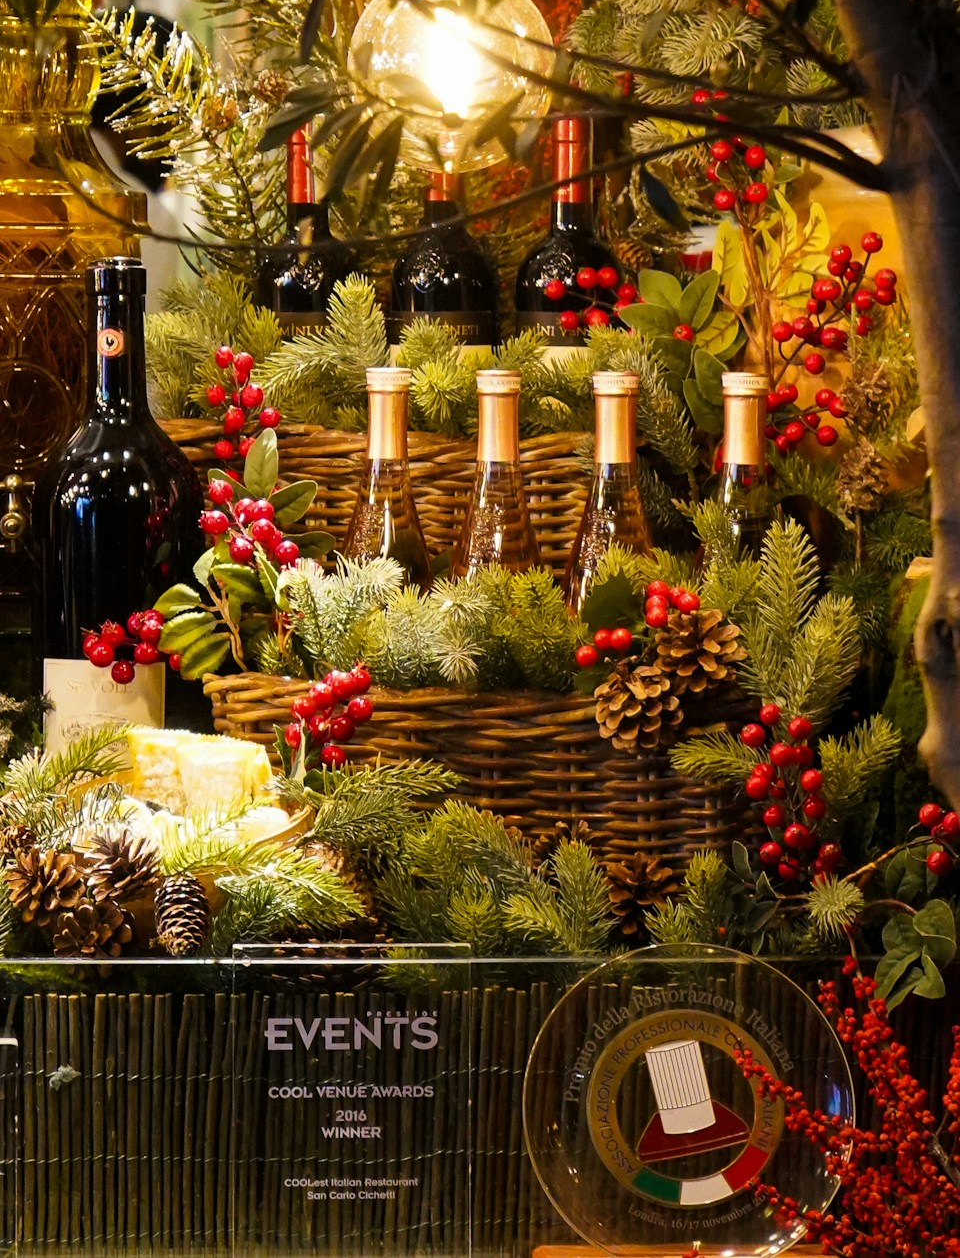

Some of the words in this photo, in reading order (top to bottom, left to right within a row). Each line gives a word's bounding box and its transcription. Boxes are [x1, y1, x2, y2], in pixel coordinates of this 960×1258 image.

[366, 1010, 438, 1018] PRESTIGE
[264, 1017, 439, 1051] EVENTS
[563, 1038, 598, 1105] Premio
[592, 1006, 630, 1040] della
[630, 984, 743, 1018] Ristorazione
[743, 1007, 796, 1073] Italiana
[613, 1019, 721, 1065] PROFESSIONALE
[268, 1086, 314, 1099] COOL
[316, 1086, 368, 1099] VENUE
[371, 1085, 435, 1099] AWARDS
[335, 1109, 368, 1122] 2016
[595, 1068, 636, 1175] ASSOCIAZIONE
[321, 1126, 382, 1139] WINNER
[284, 1177, 329, 1188] COOLest
[330, 1177, 362, 1188] Italian
[364, 1176, 419, 1188] Restaurant
[306, 1190, 327, 1201] San
[329, 1190, 356, 1201] Carlo
[628, 1203, 668, 1229] Londra,
[671, 1218, 700, 1231] 16/17
[701, 1202, 753, 1229] novembre
